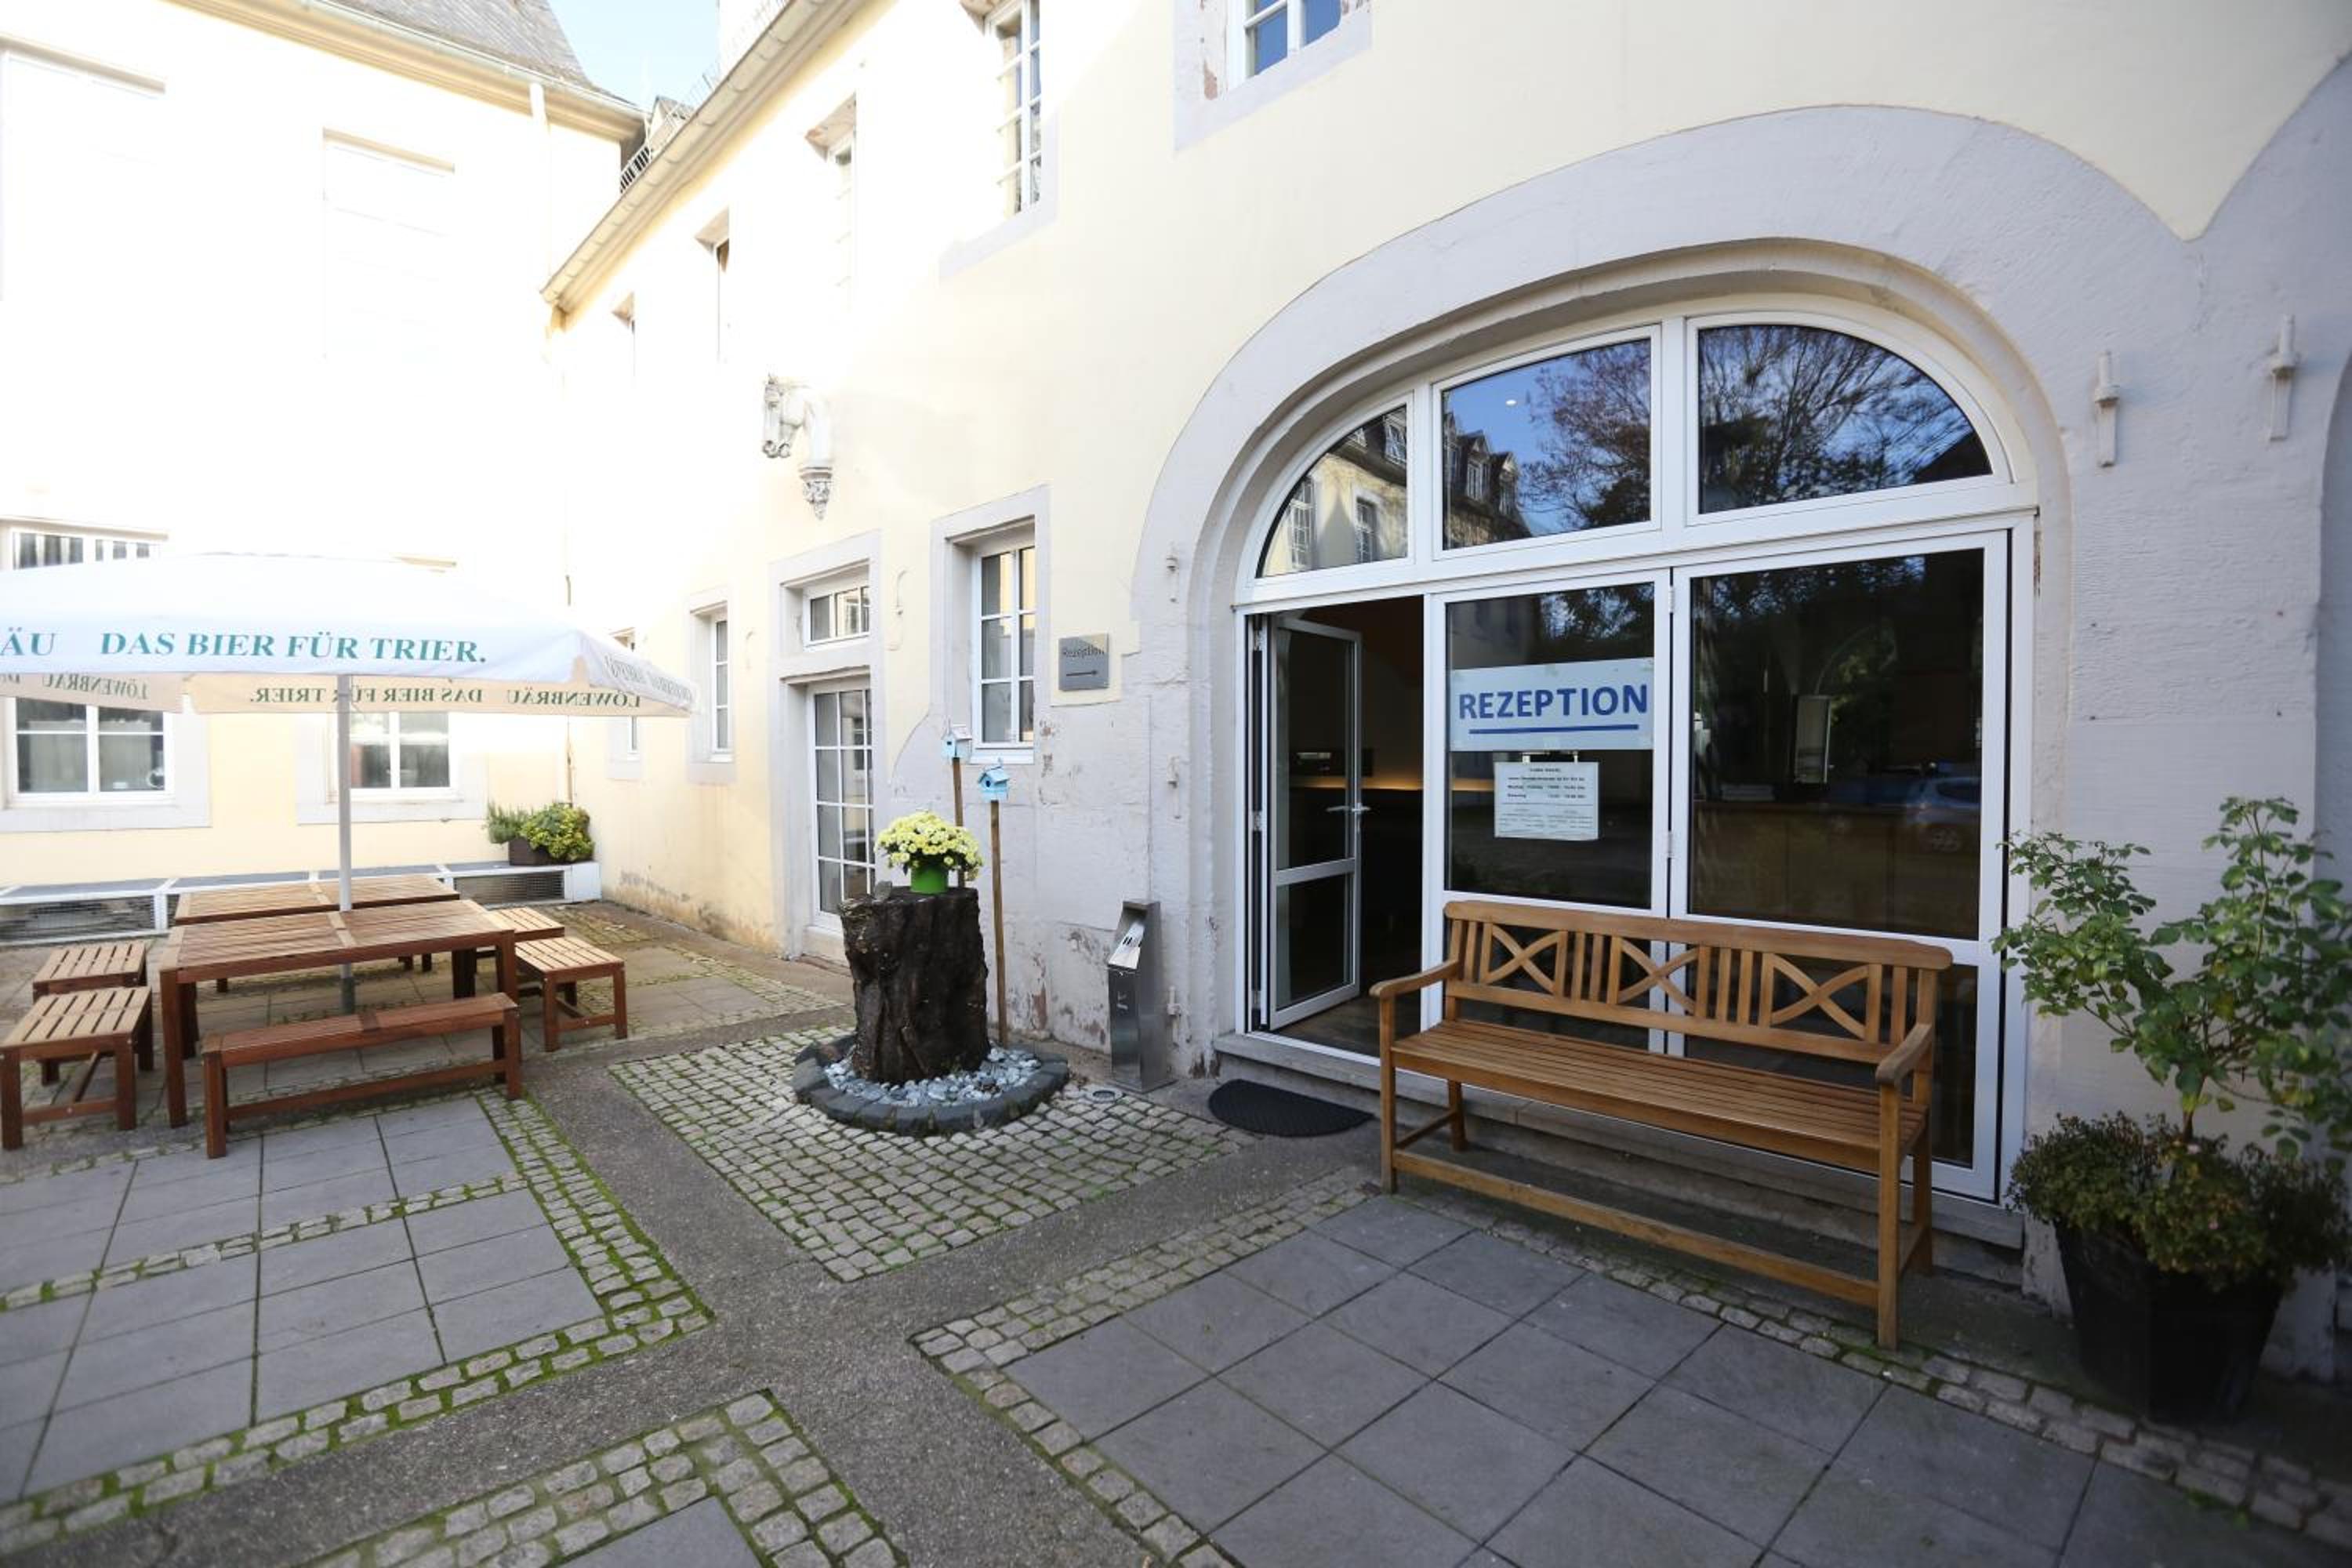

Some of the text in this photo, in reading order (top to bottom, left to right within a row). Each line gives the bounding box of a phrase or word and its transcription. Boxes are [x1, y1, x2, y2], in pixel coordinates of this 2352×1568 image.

[0, 627, 486, 663] ÄU DAS BIER FÜR TRIER.
[1458, 684, 1648, 720] REZEPTION
